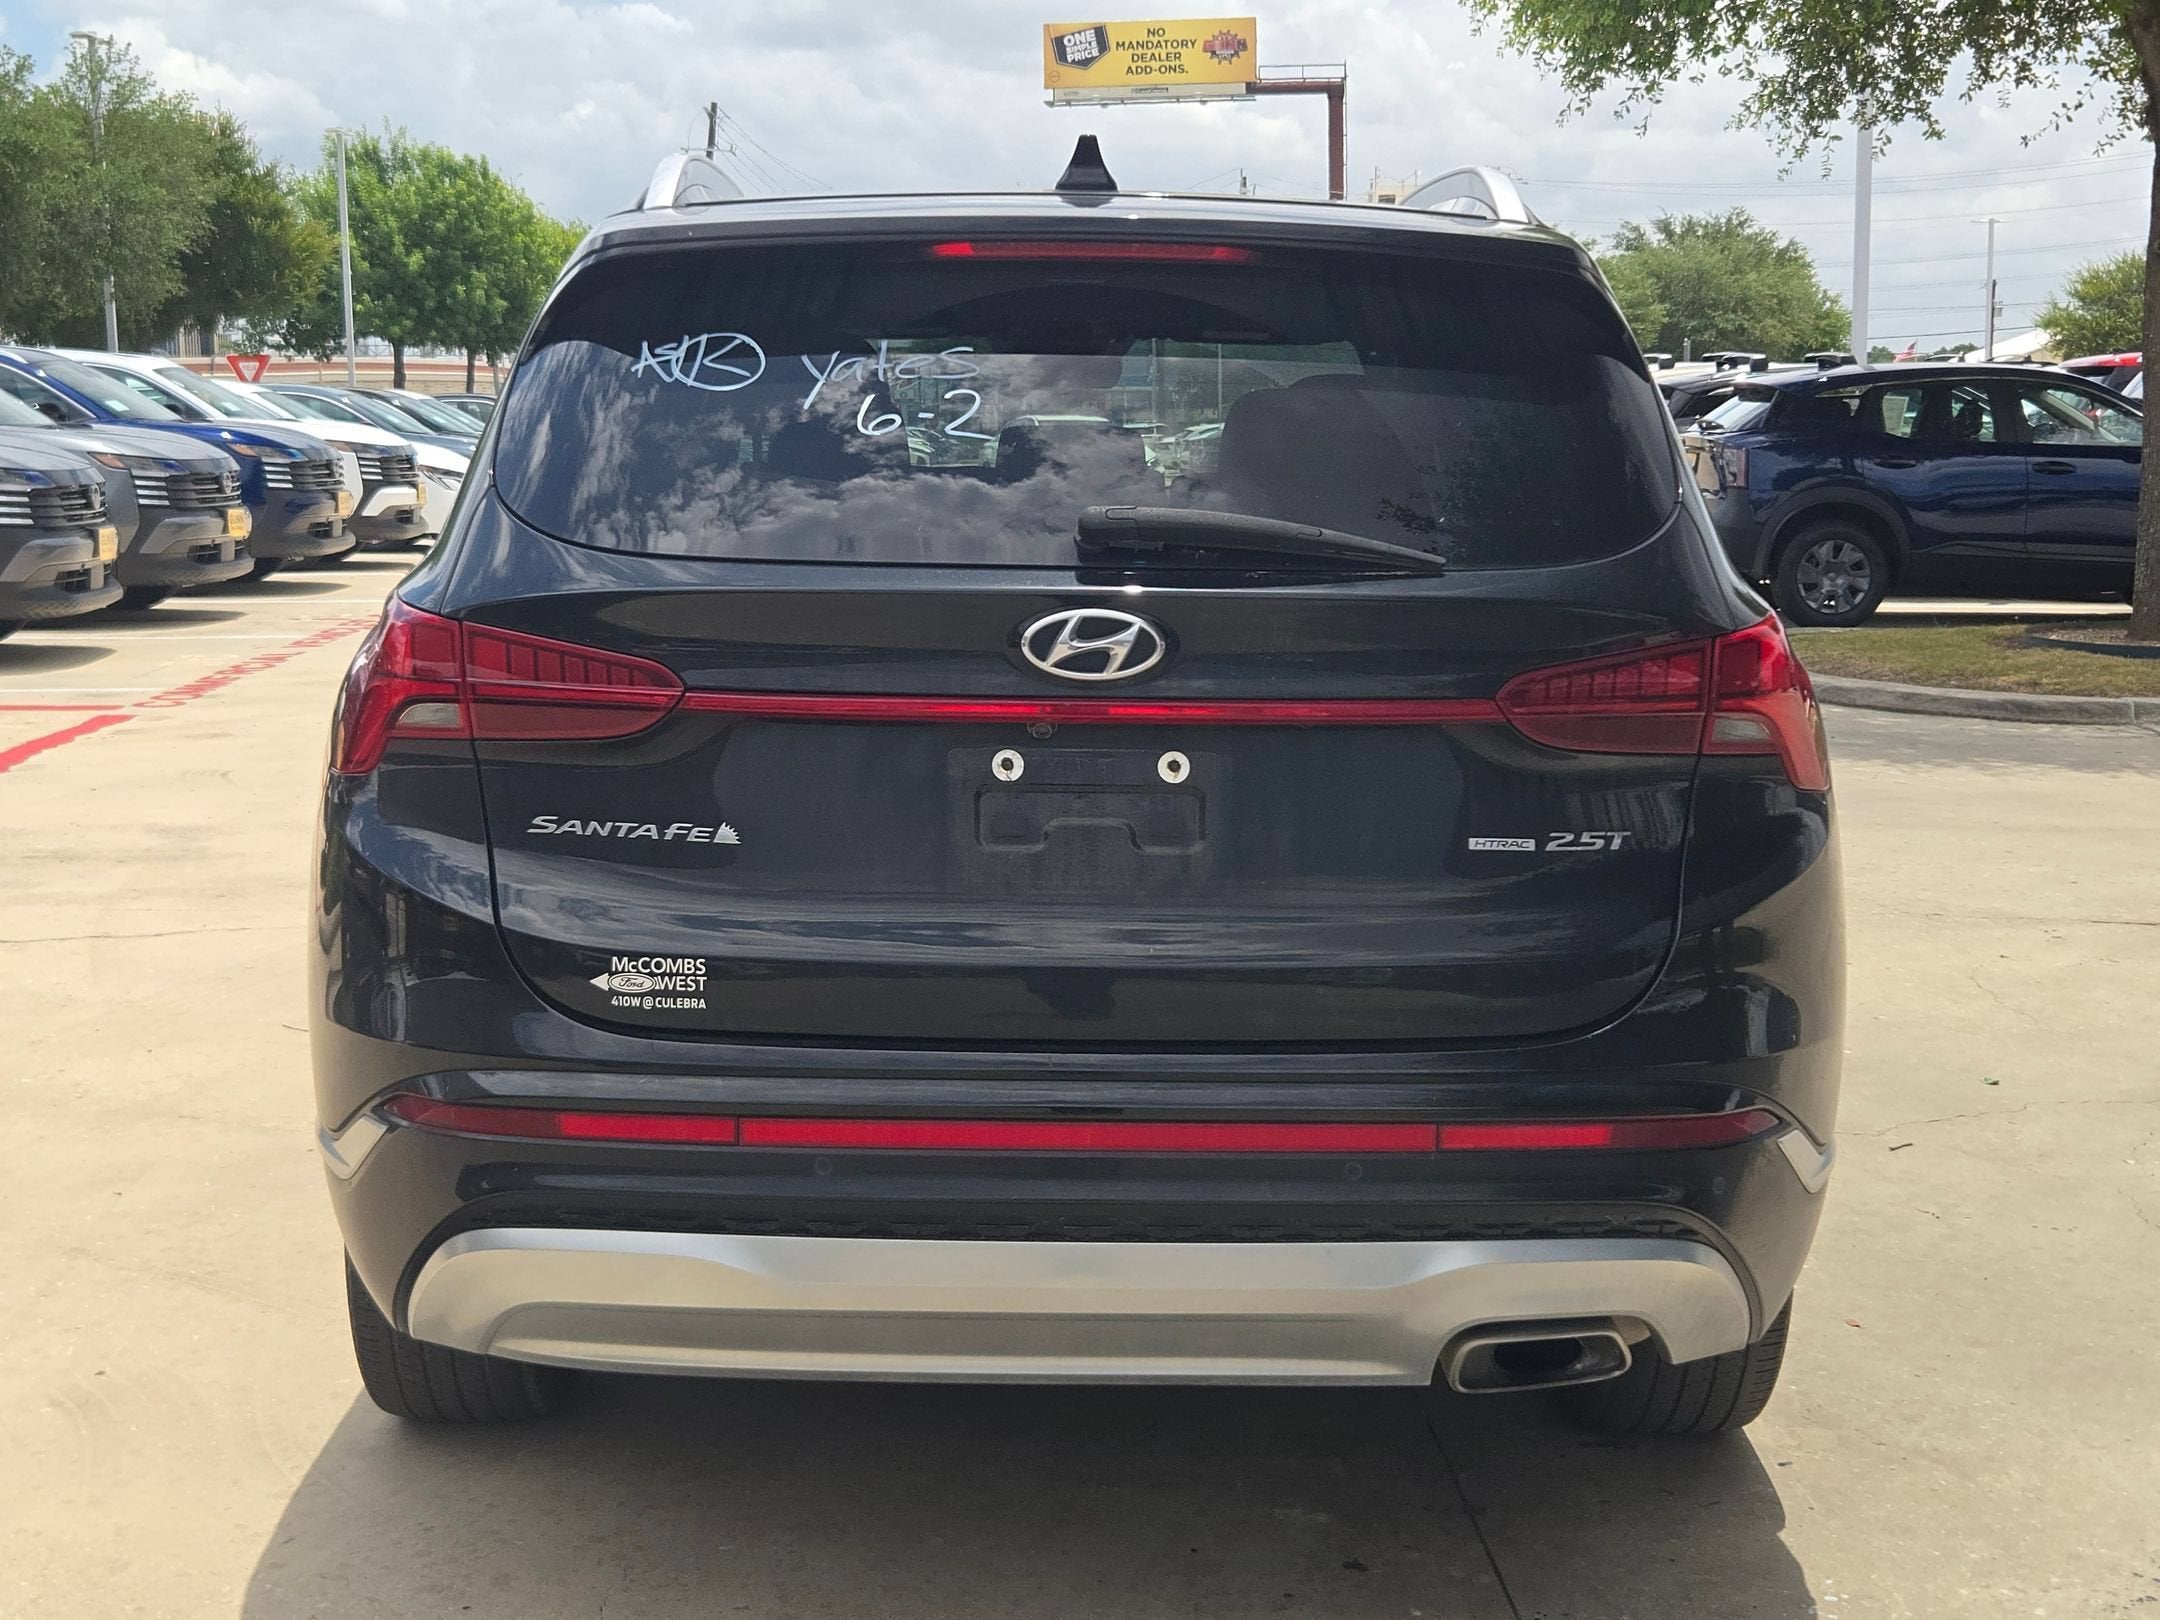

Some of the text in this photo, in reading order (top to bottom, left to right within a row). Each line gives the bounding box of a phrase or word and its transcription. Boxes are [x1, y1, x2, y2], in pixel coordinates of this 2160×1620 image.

[1063, 29, 1097, 47] ONE
[1147, 28, 1166, 38] NO
[1066, 41, 1098, 54] SIMPLE
[1115, 39, 1198, 51] MANDATORY
[1066, 47, 1100, 63] PRICE
[1131, 52, 1182, 63] DEALER
[1125, 64, 1189, 76] ADD-ONS.
[1474, 840, 1530, 849] HTRAC
[611, 956, 706, 975] McCOMBS
[618, 976, 645, 988] Ford
